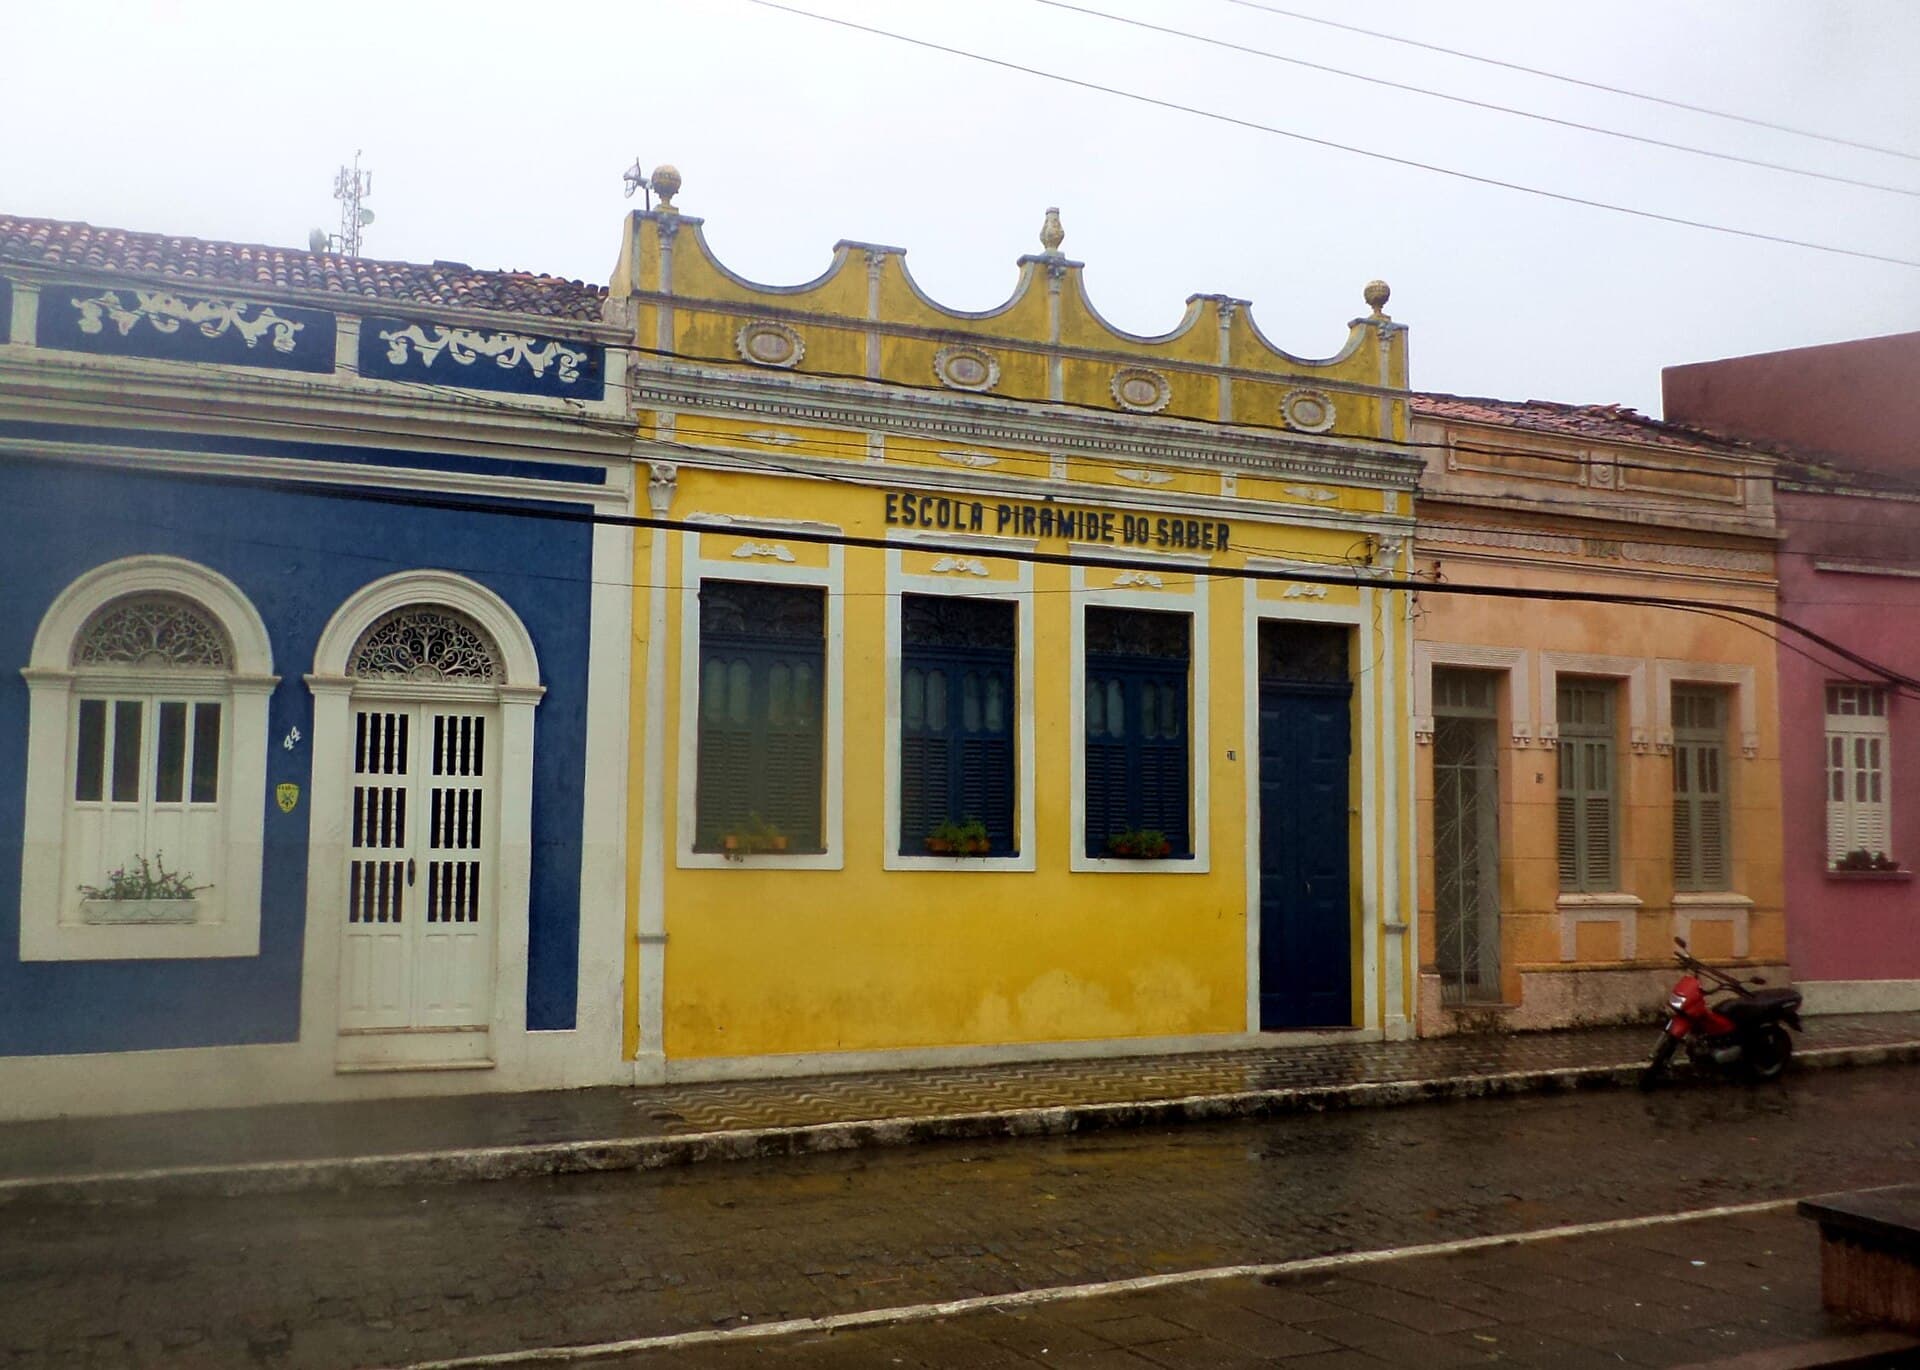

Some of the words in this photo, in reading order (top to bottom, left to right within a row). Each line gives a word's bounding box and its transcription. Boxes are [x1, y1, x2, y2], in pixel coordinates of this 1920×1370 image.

[885, 494, 982, 530] ESCOLA
[997, 495, 1115, 542] PIRÂMIDE
[1123, 514, 1149, 544] DO
[1157, 518, 1230, 552] SABER
[283, 725, 301, 750] 44
